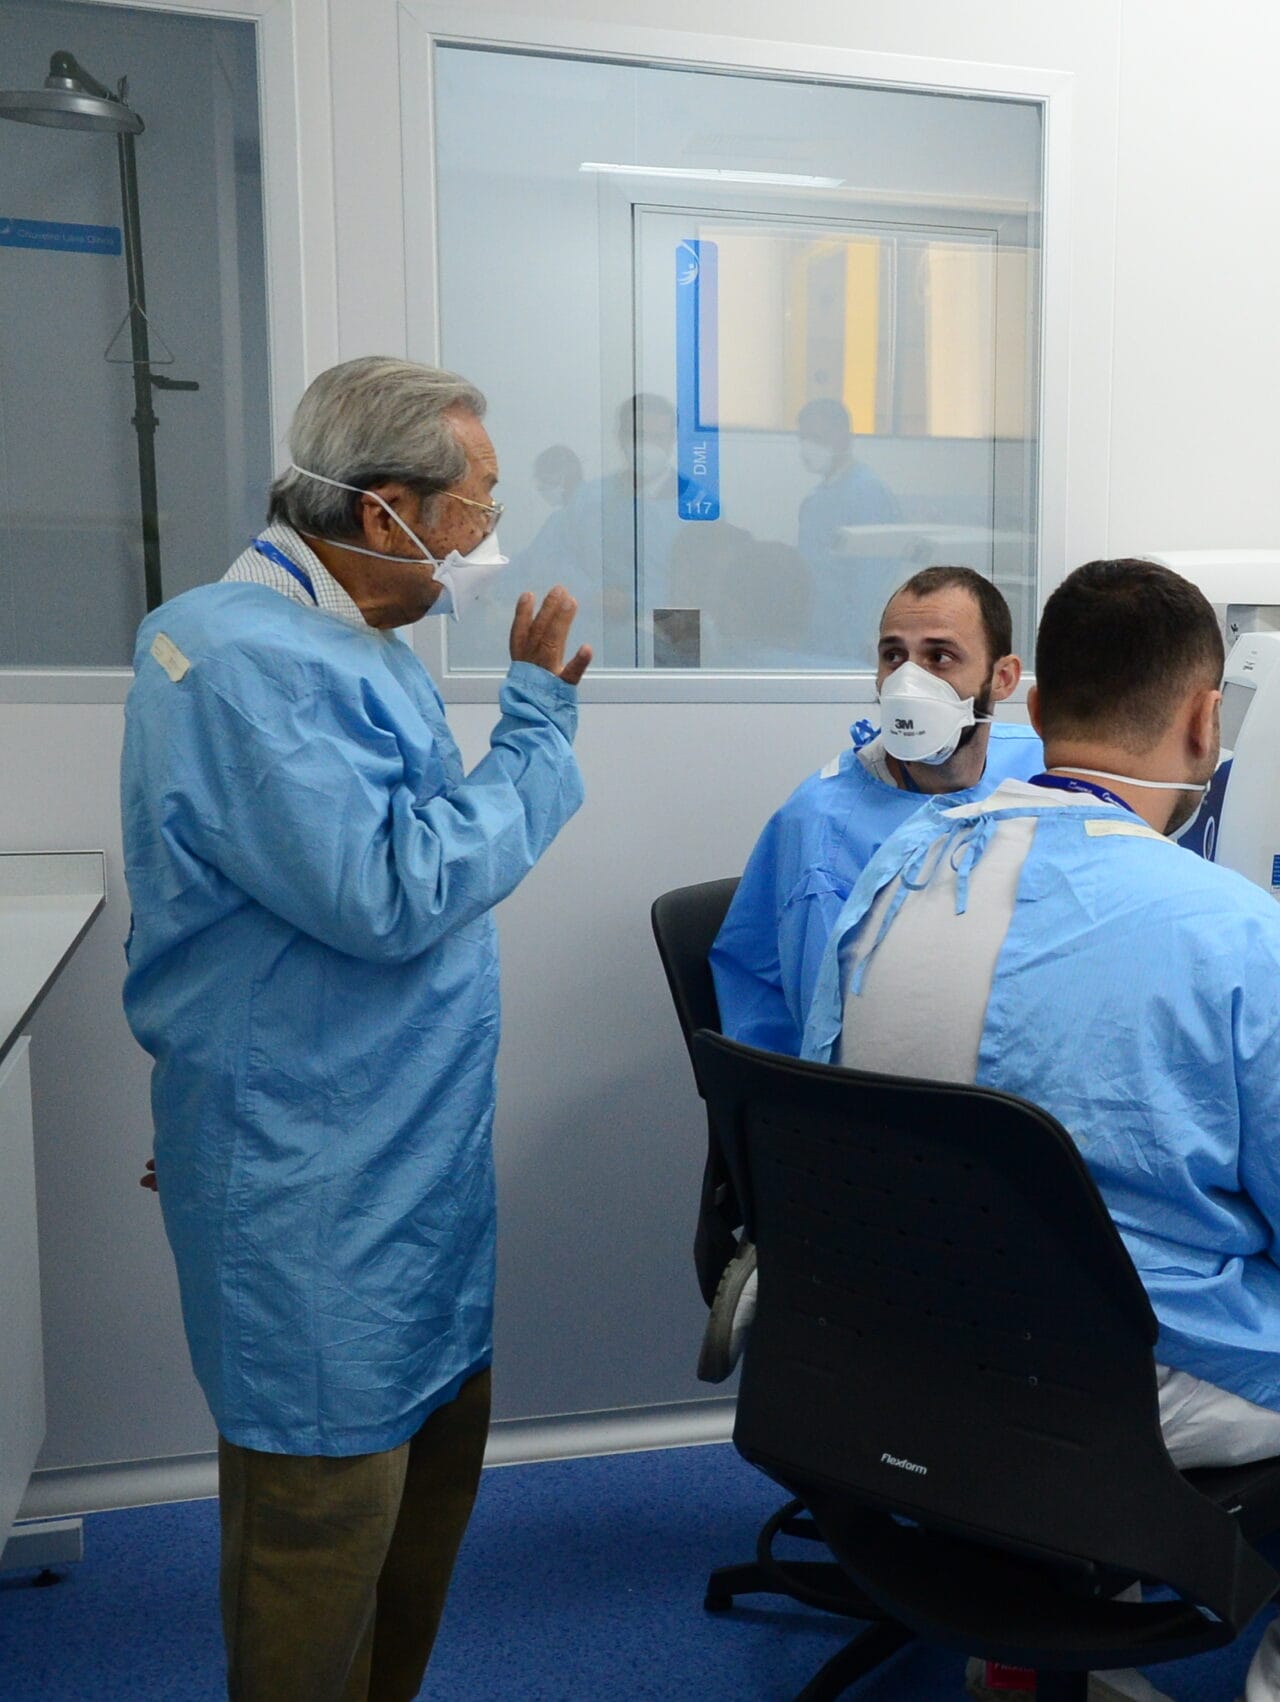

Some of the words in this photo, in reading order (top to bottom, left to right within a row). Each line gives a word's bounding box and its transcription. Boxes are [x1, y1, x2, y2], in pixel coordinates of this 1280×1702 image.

[693, 441, 707, 475] DML
[686, 502, 712, 514] 117
[894, 718, 914, 730] 3M
[880, 1452, 928, 1475] Flexform
